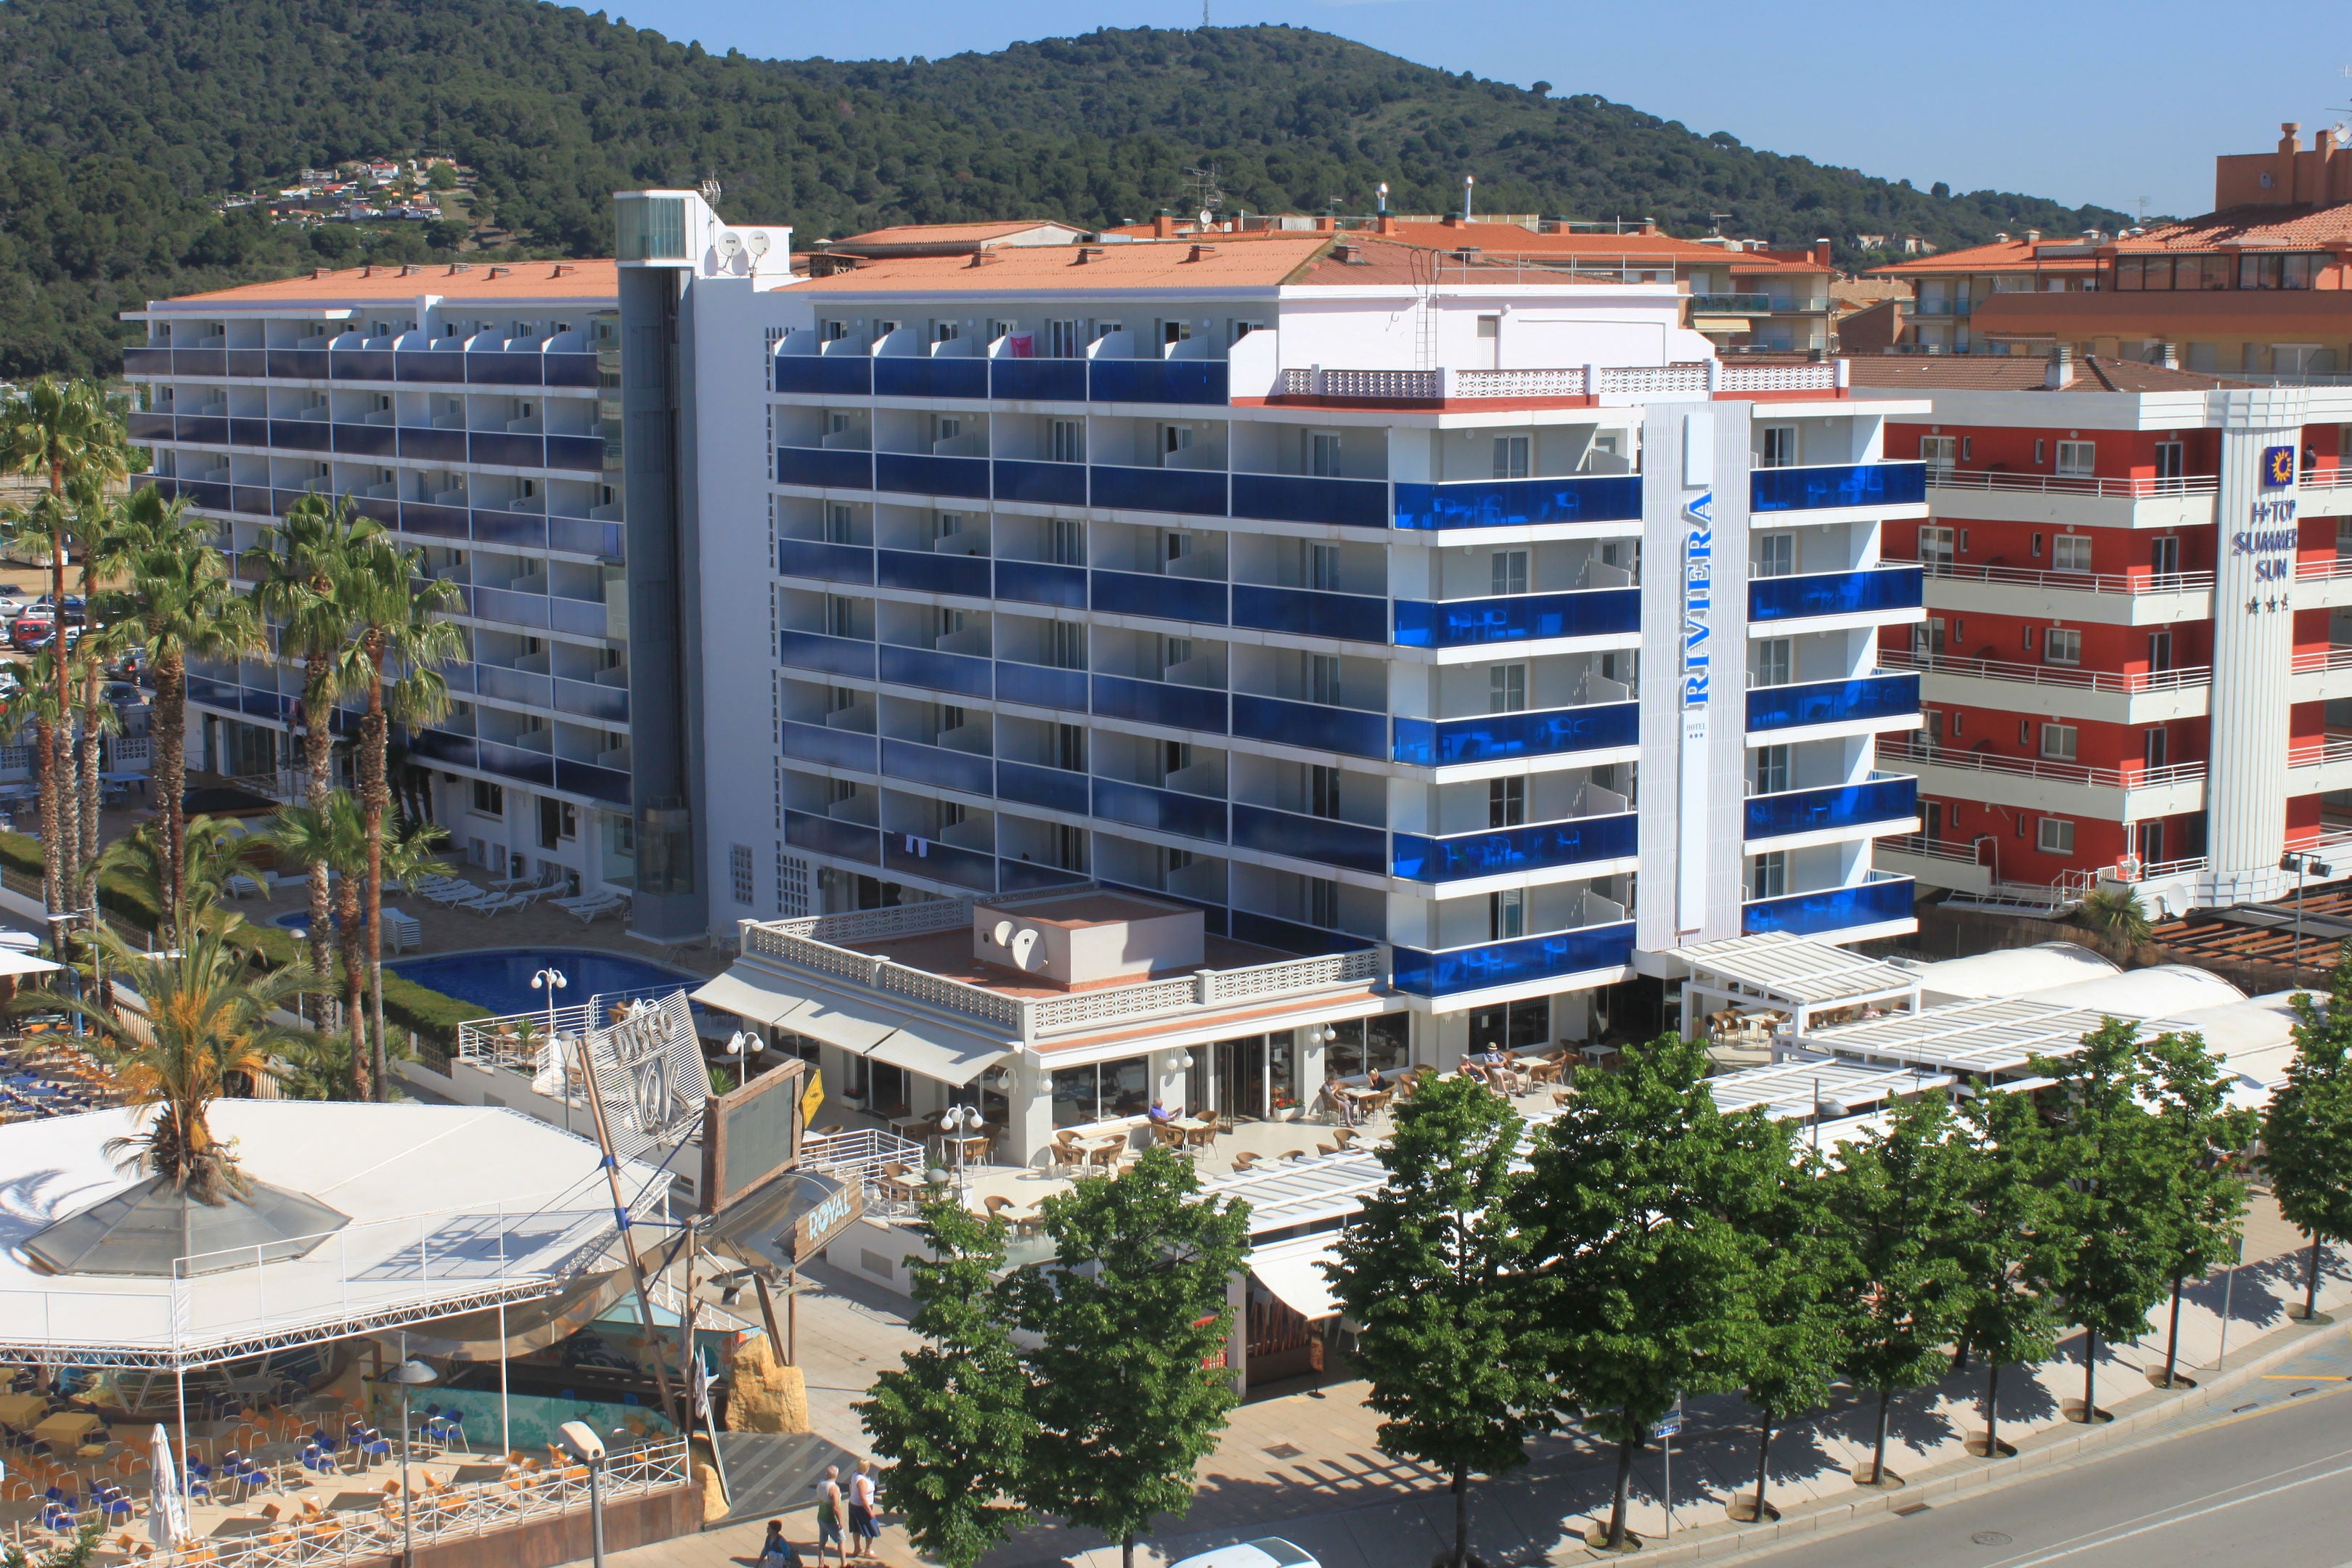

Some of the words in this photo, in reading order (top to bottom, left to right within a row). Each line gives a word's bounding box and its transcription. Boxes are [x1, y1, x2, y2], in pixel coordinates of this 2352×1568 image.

[2234, 529, 2297, 554] SUMMER
[2255, 558, 2288, 581] SUN
[1685, 489, 1712, 708] RIVIERA
[616, 1007, 676, 1061] DISCO
[809, 1188, 852, 1241] ROYAL
